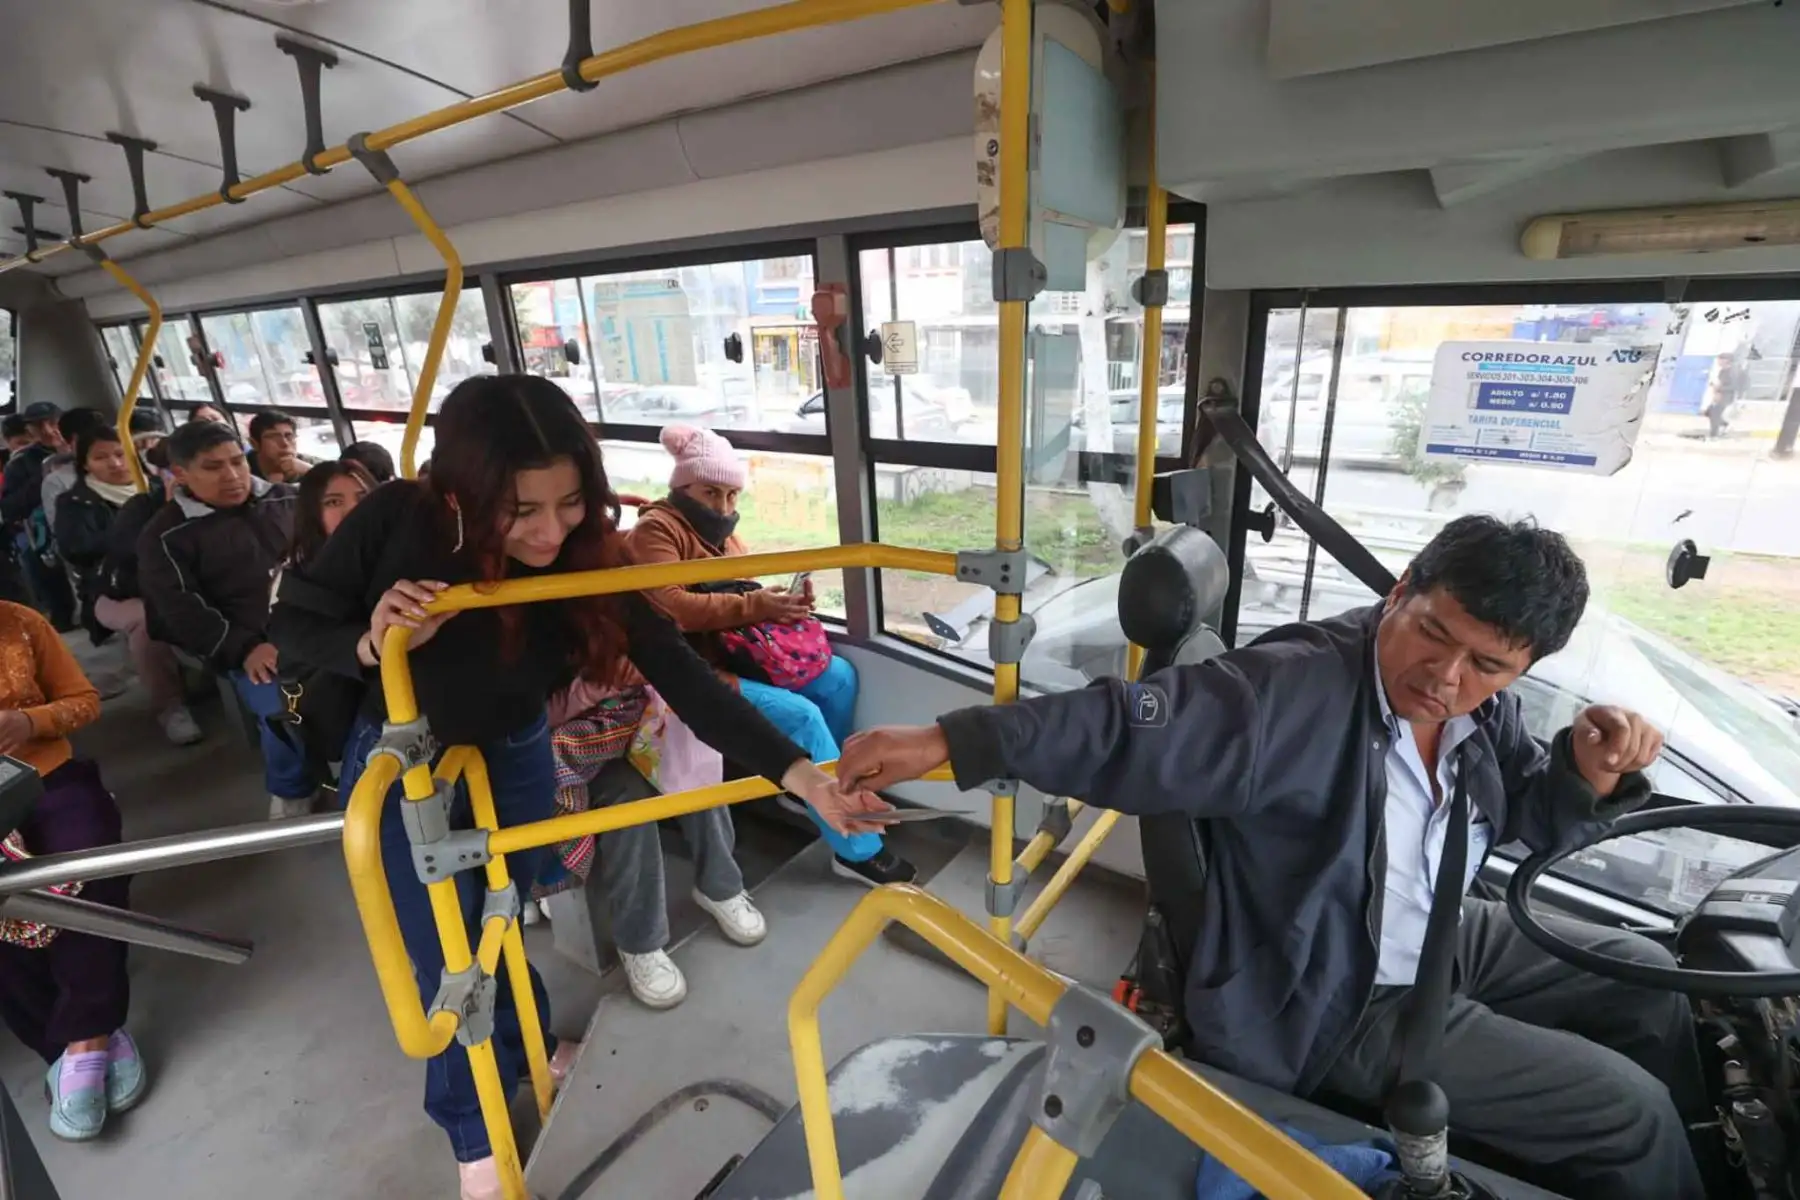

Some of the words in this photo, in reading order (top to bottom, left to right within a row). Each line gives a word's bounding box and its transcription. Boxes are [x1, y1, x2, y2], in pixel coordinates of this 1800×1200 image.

[1461, 351, 1550, 364] CORREDOR
[1552, 355, 1598, 367] AZUL
[1490, 389, 1525, 398] ADULTO
[1468, 414, 1499, 426] TARIFA
[1500, 416, 1562, 430] DIFERENCIAL
